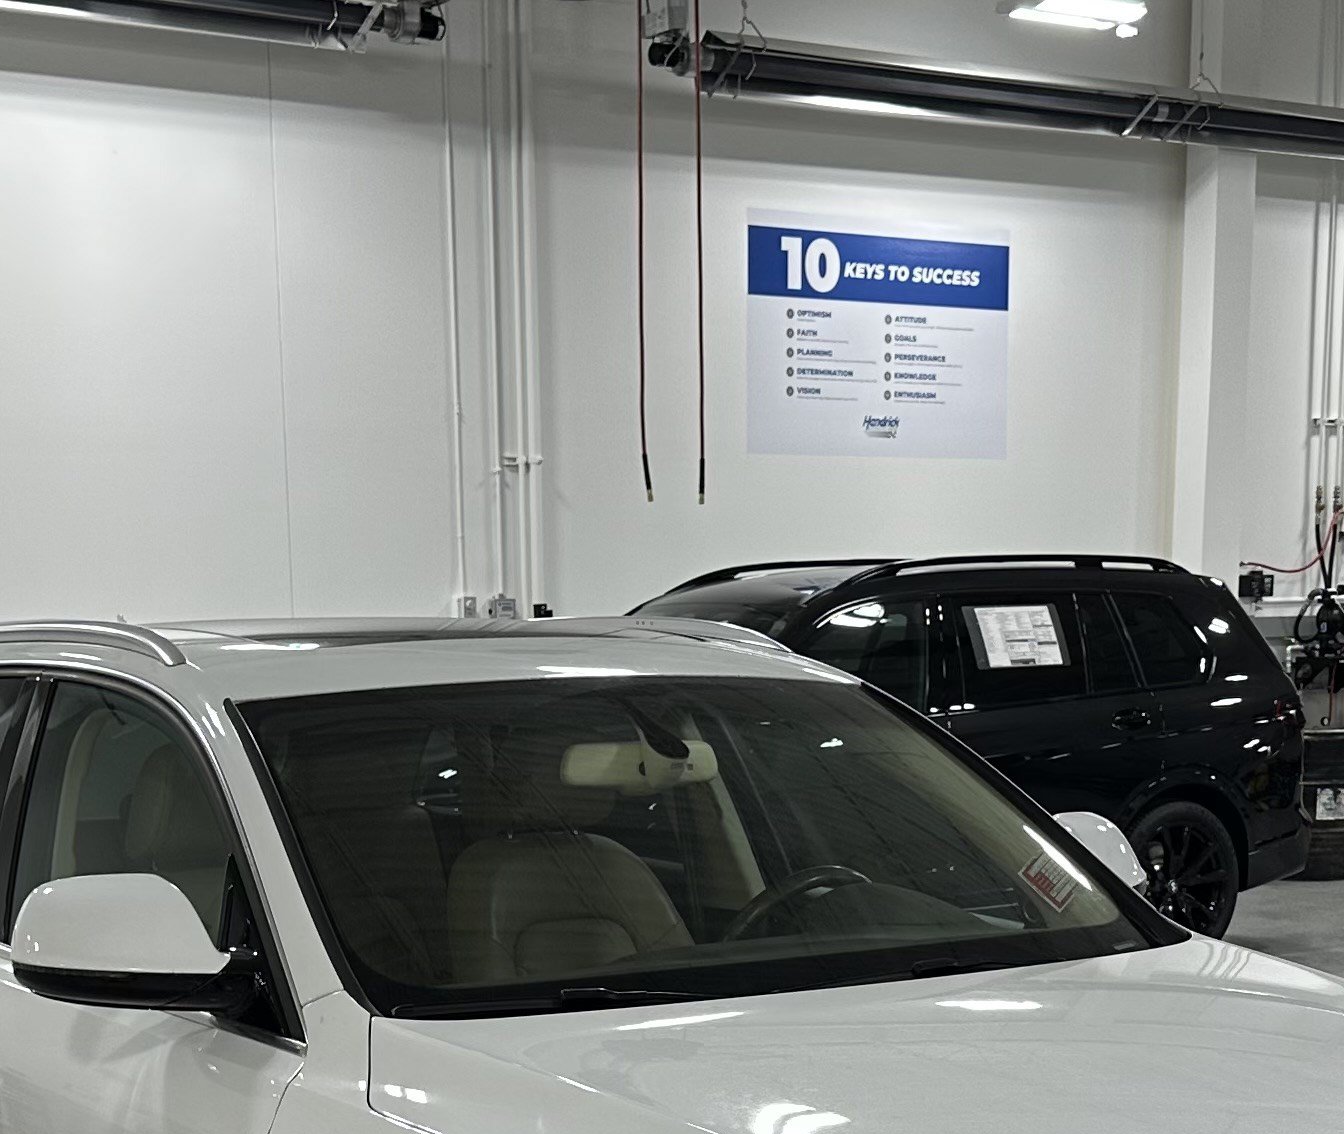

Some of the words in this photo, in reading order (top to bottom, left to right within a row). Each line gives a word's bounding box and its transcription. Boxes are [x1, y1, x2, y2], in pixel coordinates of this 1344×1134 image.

[780, 236, 841, 293] 10
[844, 262, 885, 280] KEYS
[888, 264, 910, 282] TO
[912, 266, 981, 287] SUCCESS
[797, 329, 818, 337] FAITH
